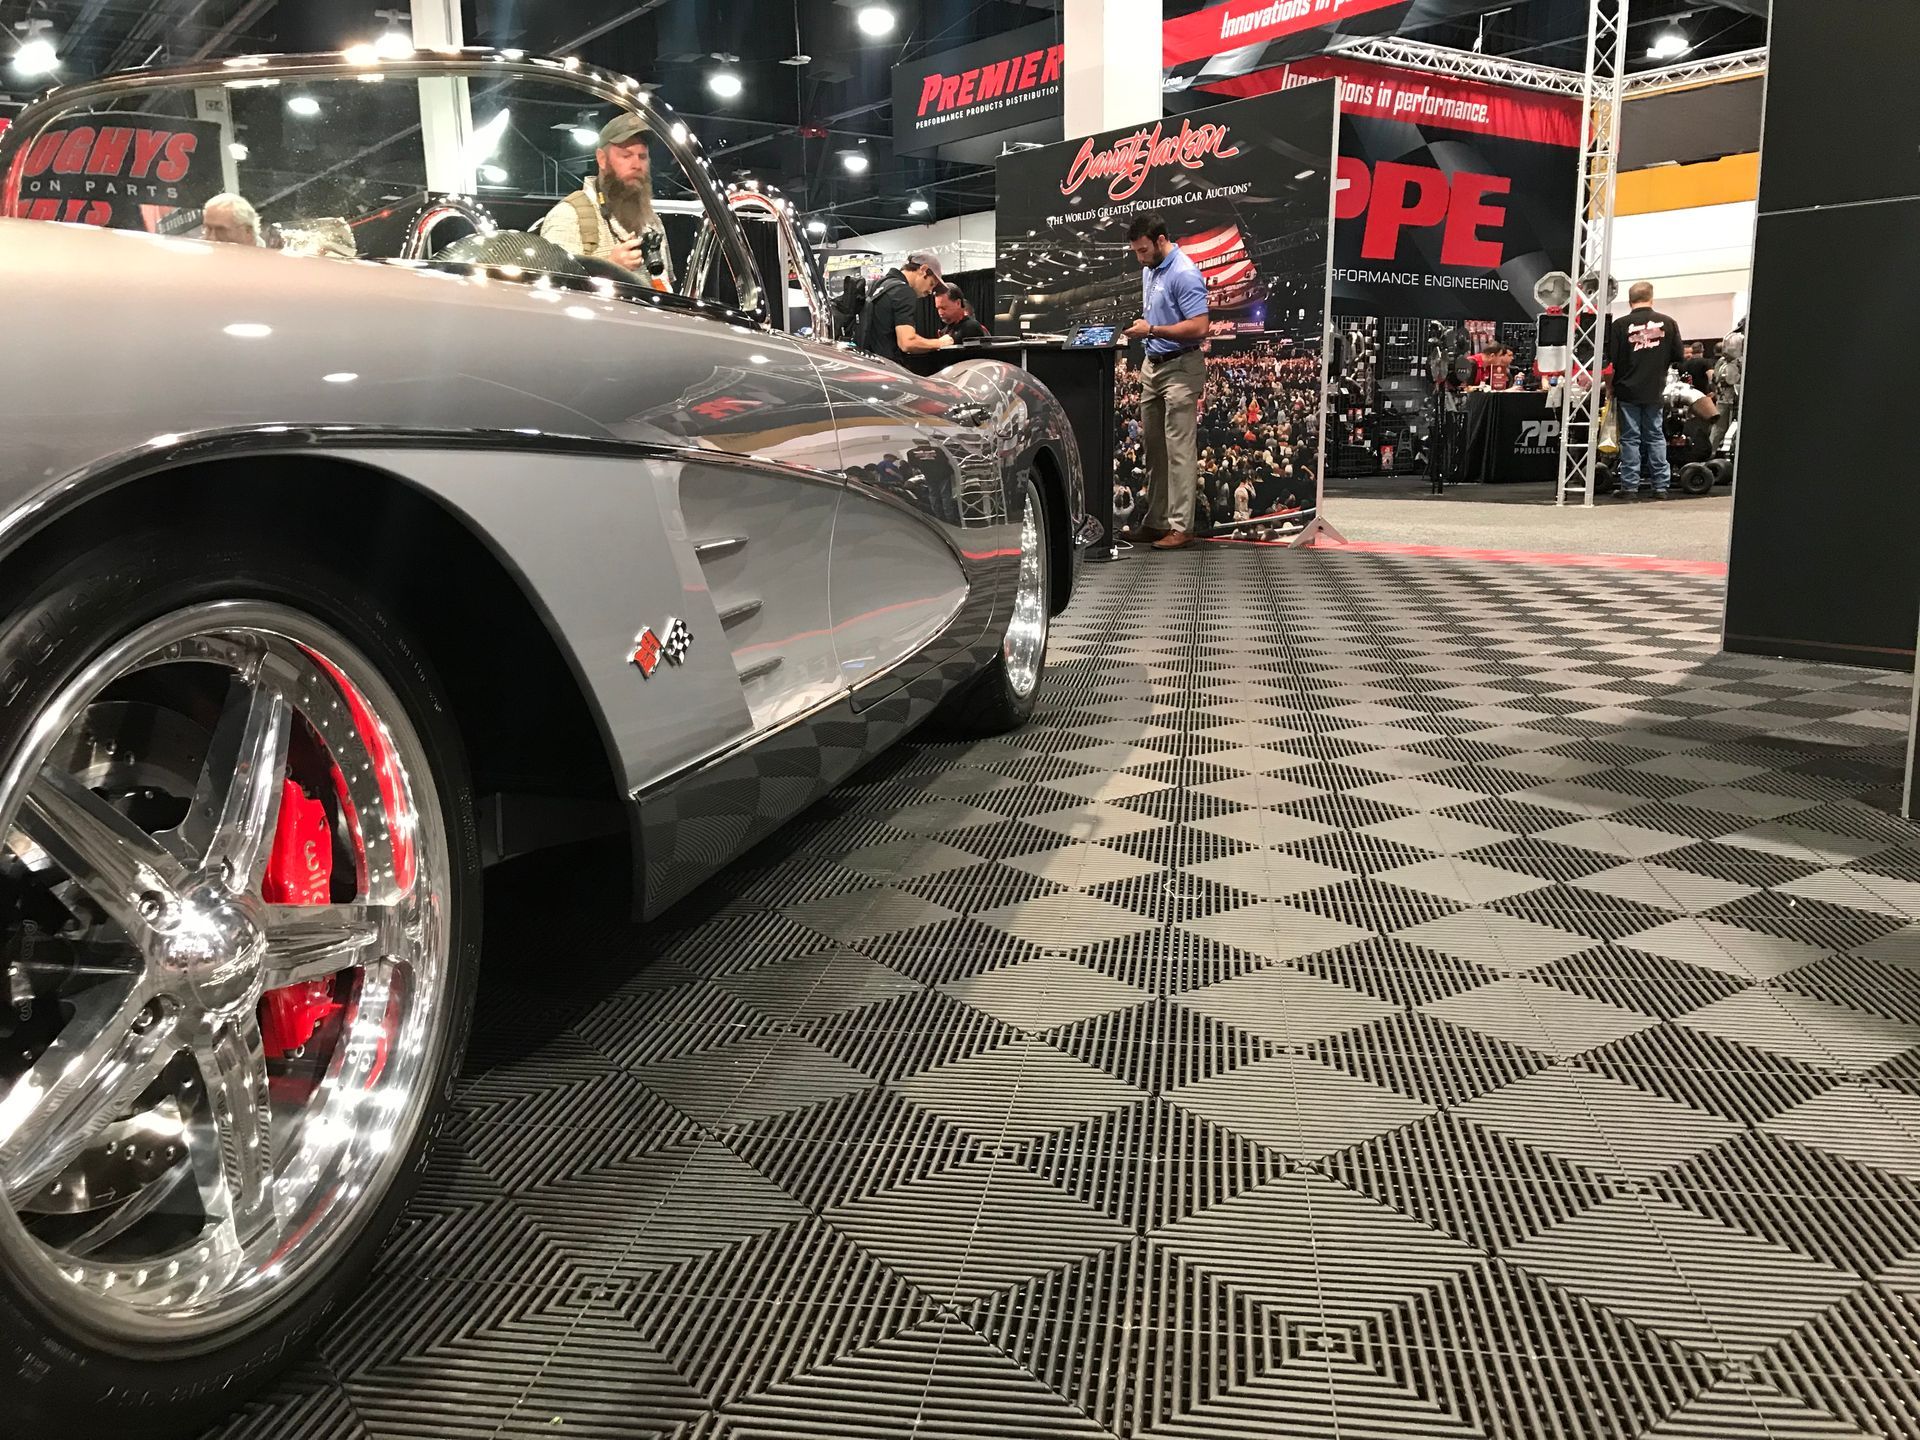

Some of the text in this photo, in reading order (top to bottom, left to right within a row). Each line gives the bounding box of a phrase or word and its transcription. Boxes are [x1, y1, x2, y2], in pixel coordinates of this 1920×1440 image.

[915, 110, 963, 129] PERFORMANCE
[966, 101, 1003, 117] PRODUCTS
[1377, 81, 1390, 108] in
[1393, 86, 1489, 124] performance.
[24, 126, 197, 182] UGHYS
[86, 181, 178, 198] PARTS
[1048, 215, 1063, 226] THE
[1065, 208, 1096, 224] WORLD'S
[1097, 203, 1134, 217] GREATEST
[1136, 195, 1183, 211] COLLECTOR
[1184, 191, 1202, 203] CAR
[1332, 268, 1509, 292] RFORMANCE ENGINEERING
[1514, 420, 1560, 447] PP
